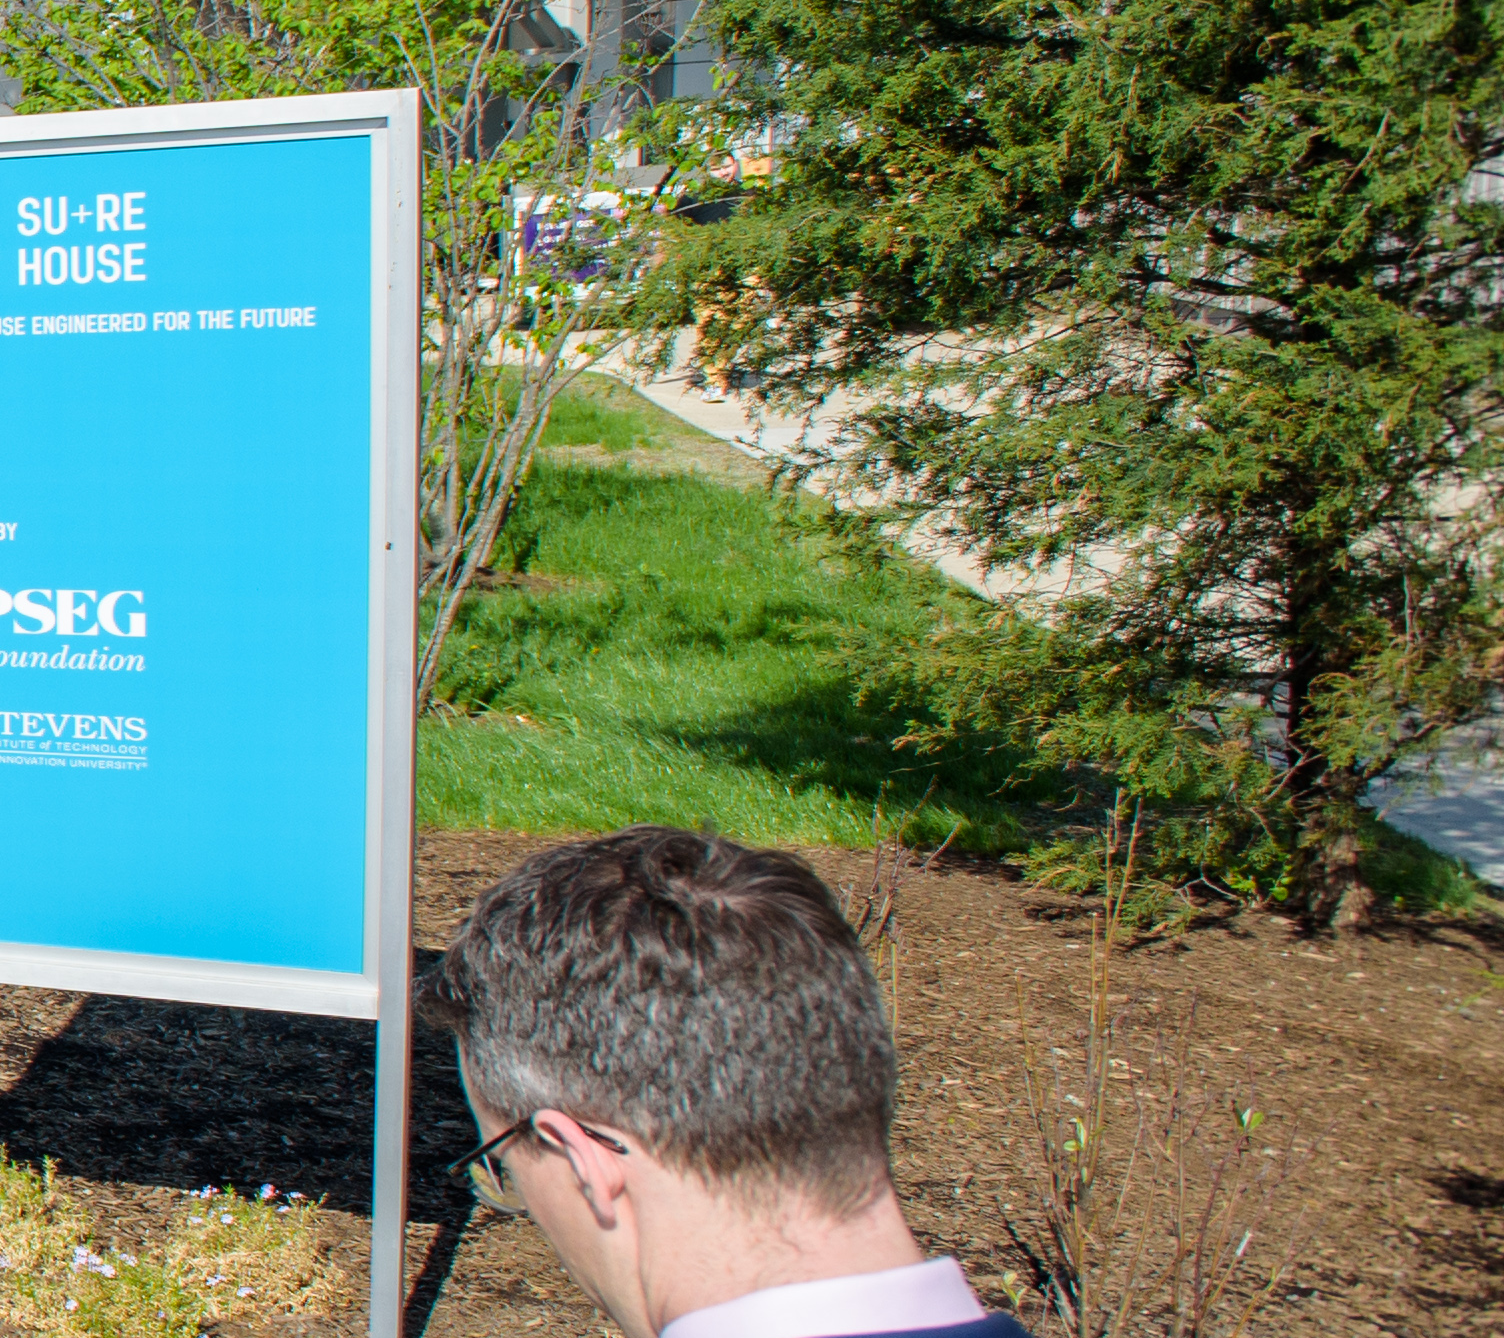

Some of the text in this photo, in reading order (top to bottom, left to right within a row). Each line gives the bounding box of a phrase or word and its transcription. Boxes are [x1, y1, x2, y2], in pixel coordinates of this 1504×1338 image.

[16, 191, 147, 237] SU+RE
[18, 242, 147, 287] HOUSE
[31, 312, 147, 335] ENGINEERED
[153, 311, 191, 331] FOR
[197, 309, 234, 331] THE
[240, 306, 317, 329] FUTURE
[40, 740, 51, 751] of
[56, 742, 148, 755] TECHNOLOGY
